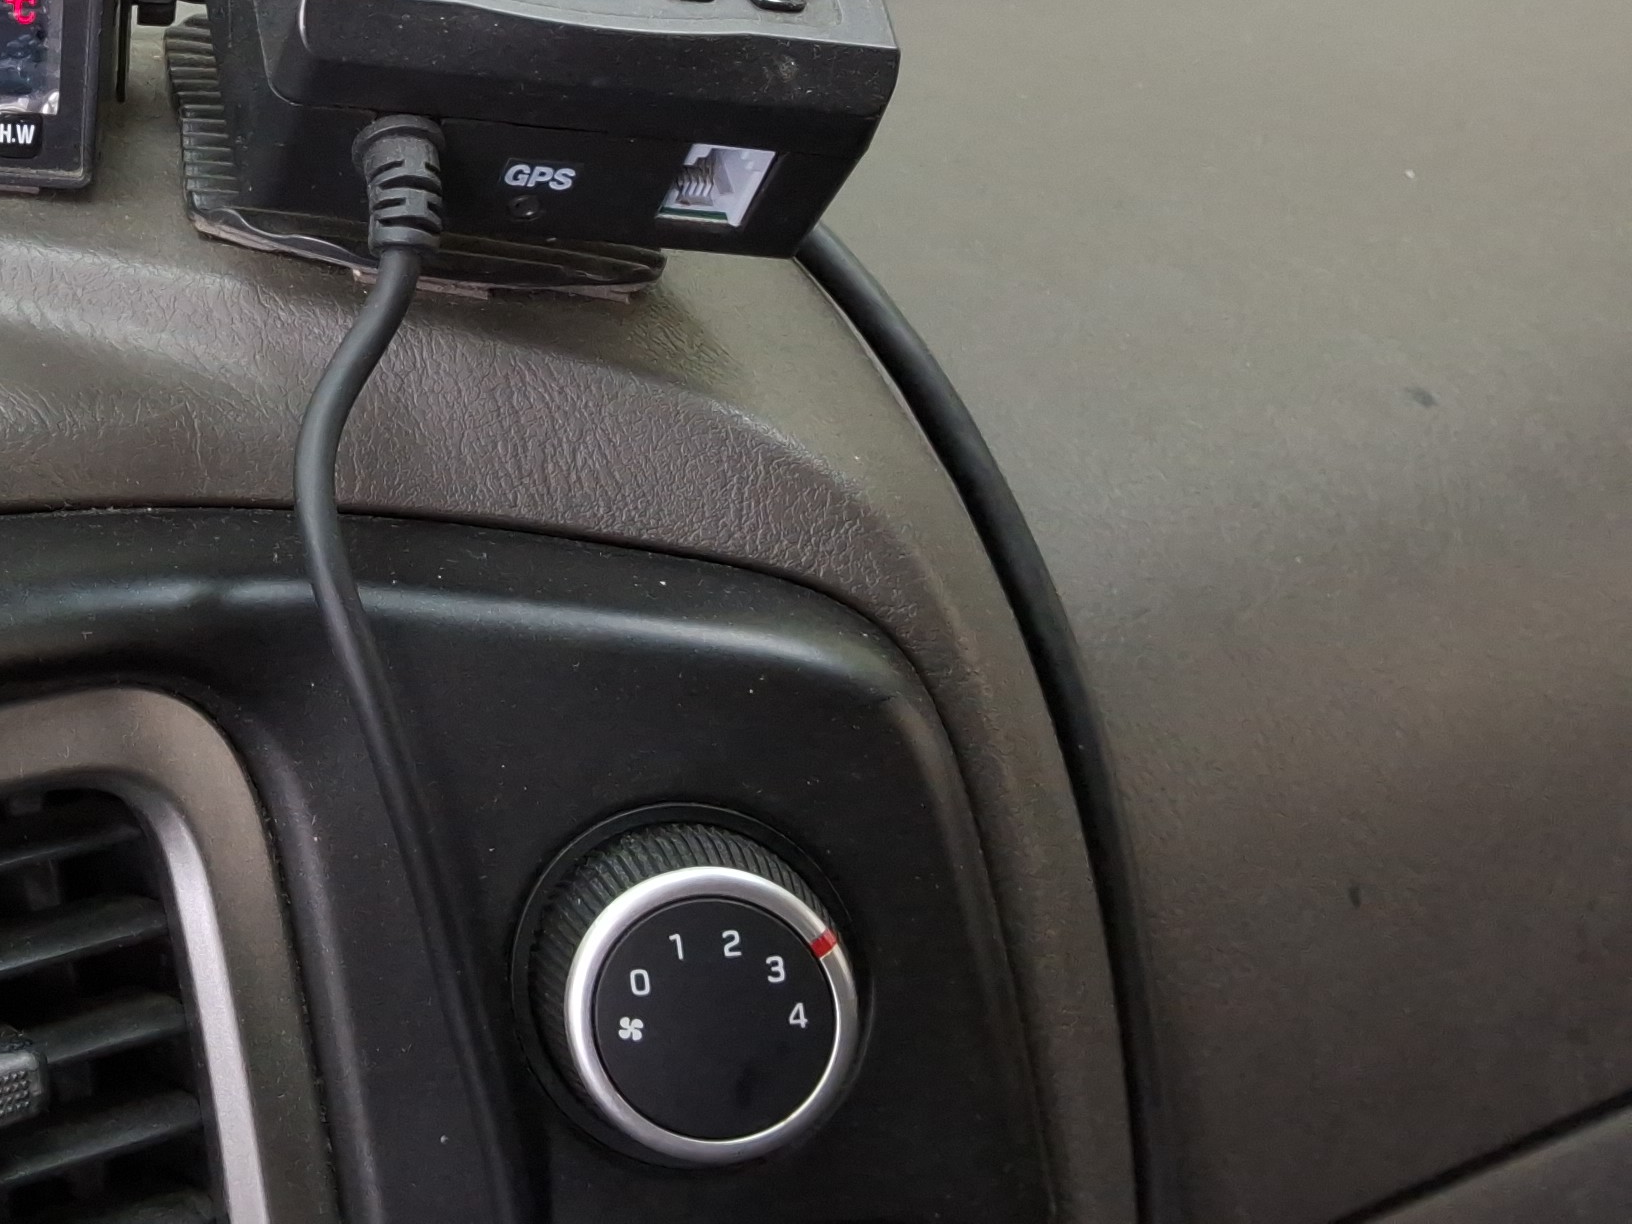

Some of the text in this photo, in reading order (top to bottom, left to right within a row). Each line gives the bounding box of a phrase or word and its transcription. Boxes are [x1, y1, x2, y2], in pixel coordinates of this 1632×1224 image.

[504, 164, 576, 190] GPS
[629, 930, 808, 1028] 0 1 2 3 4
